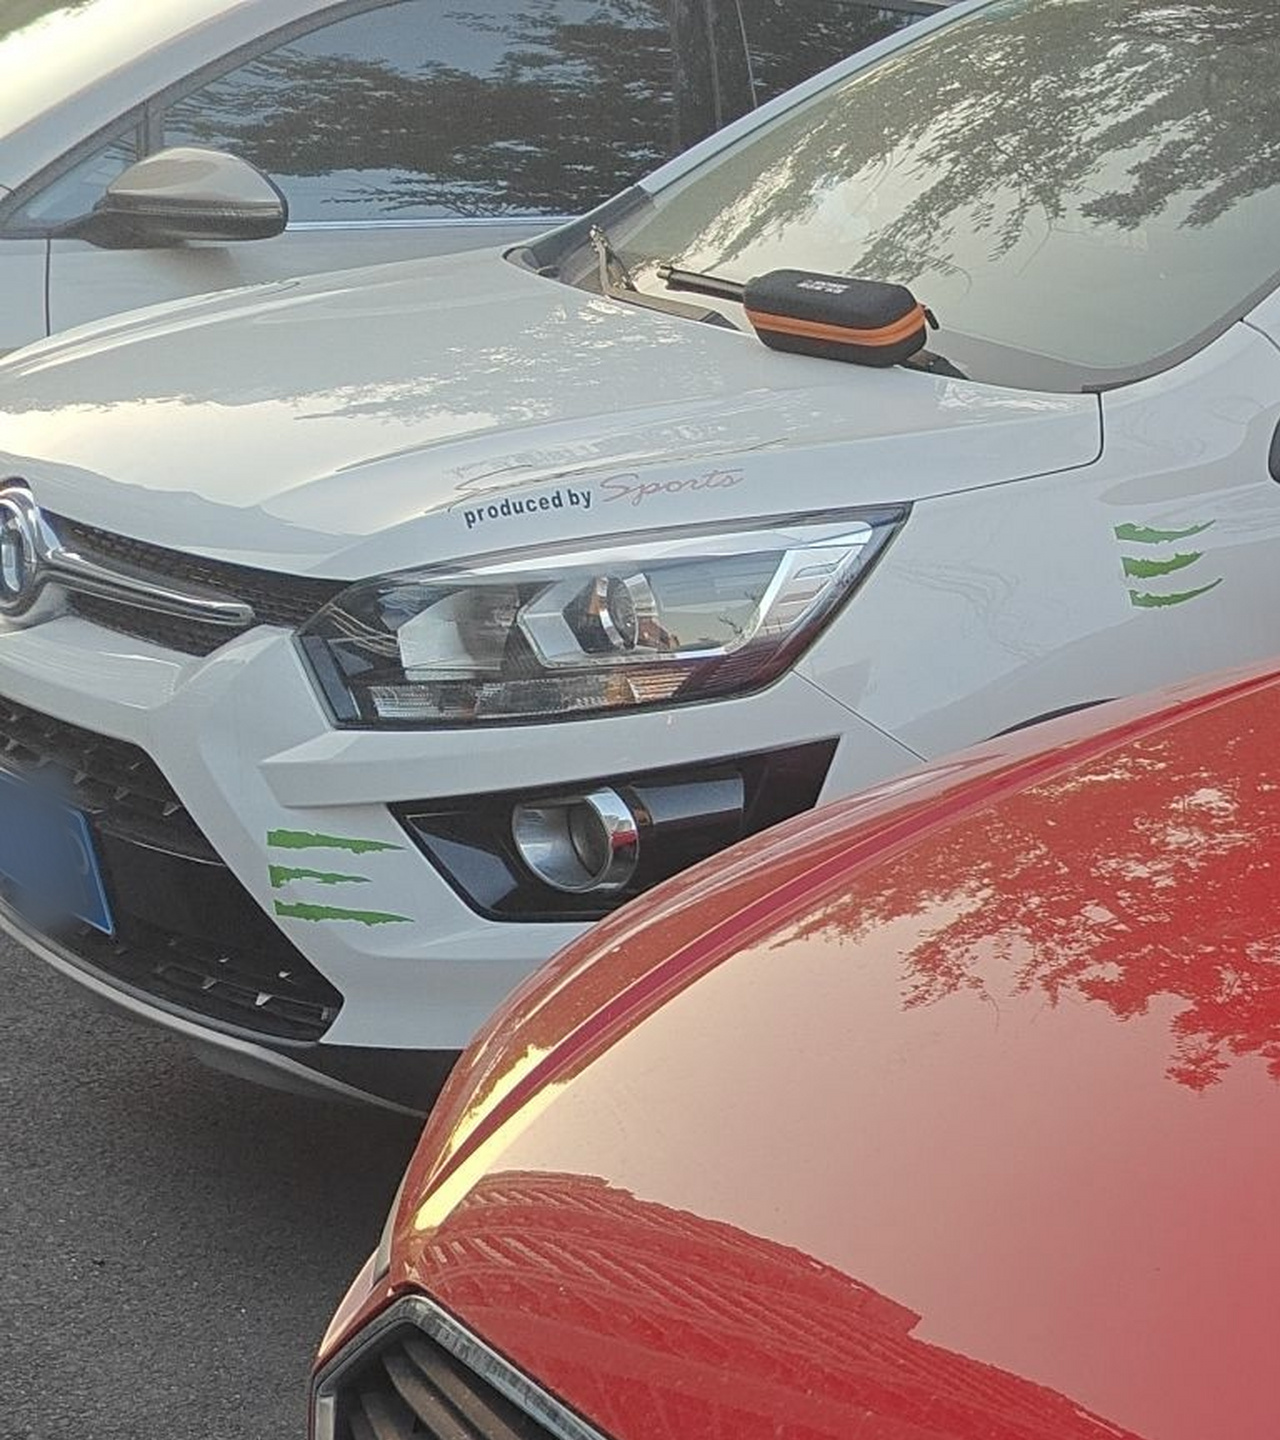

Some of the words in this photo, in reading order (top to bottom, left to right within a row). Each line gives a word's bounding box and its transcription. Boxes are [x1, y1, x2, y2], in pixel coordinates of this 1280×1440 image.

[464, 490, 563, 528] produced
[567, 488, 592, 508] by
[600, 468, 744, 506] Sports
